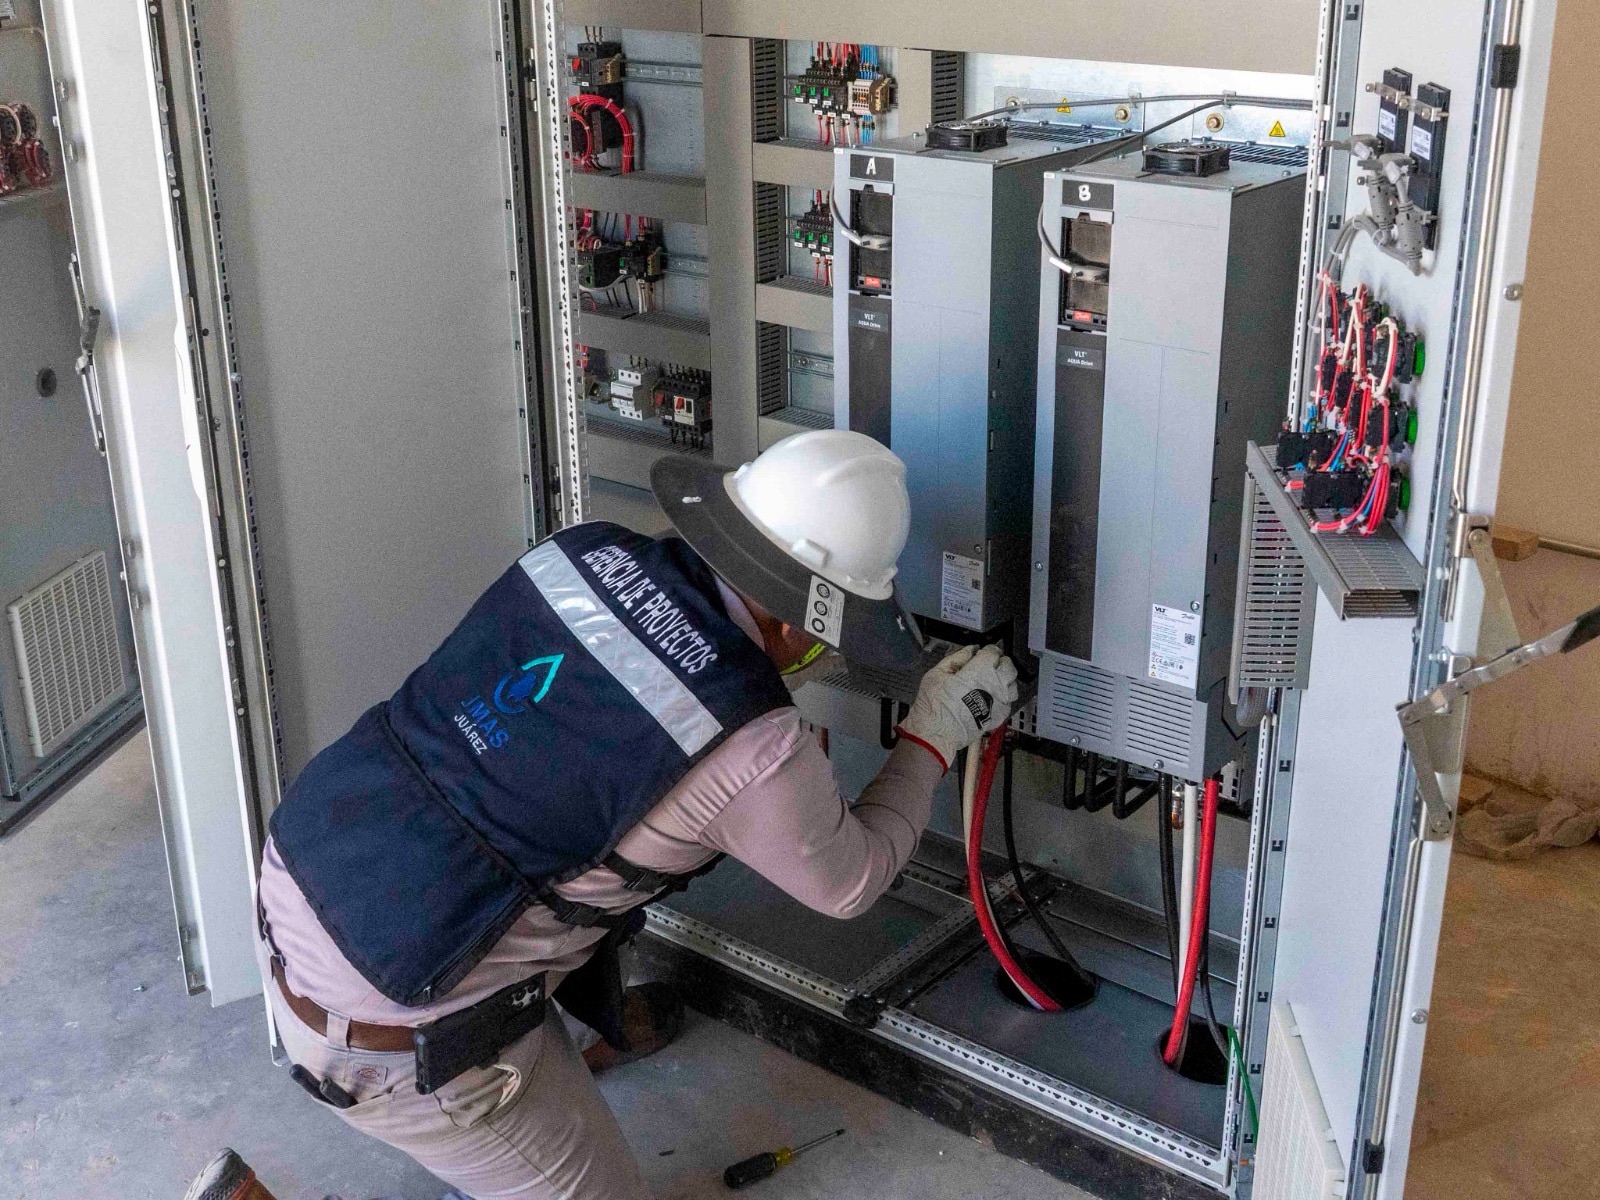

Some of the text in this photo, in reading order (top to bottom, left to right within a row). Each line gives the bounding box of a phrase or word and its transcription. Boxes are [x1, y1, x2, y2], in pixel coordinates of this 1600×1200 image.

[865, 156, 877, 175] A
[1078, 184, 1091, 202] B
[617, 577, 656, 610] DE
[632, 591, 718, 674] PROYECTOS
[454, 714, 488, 755] JUÁREZ
[461, 695, 509, 748] JMAS
